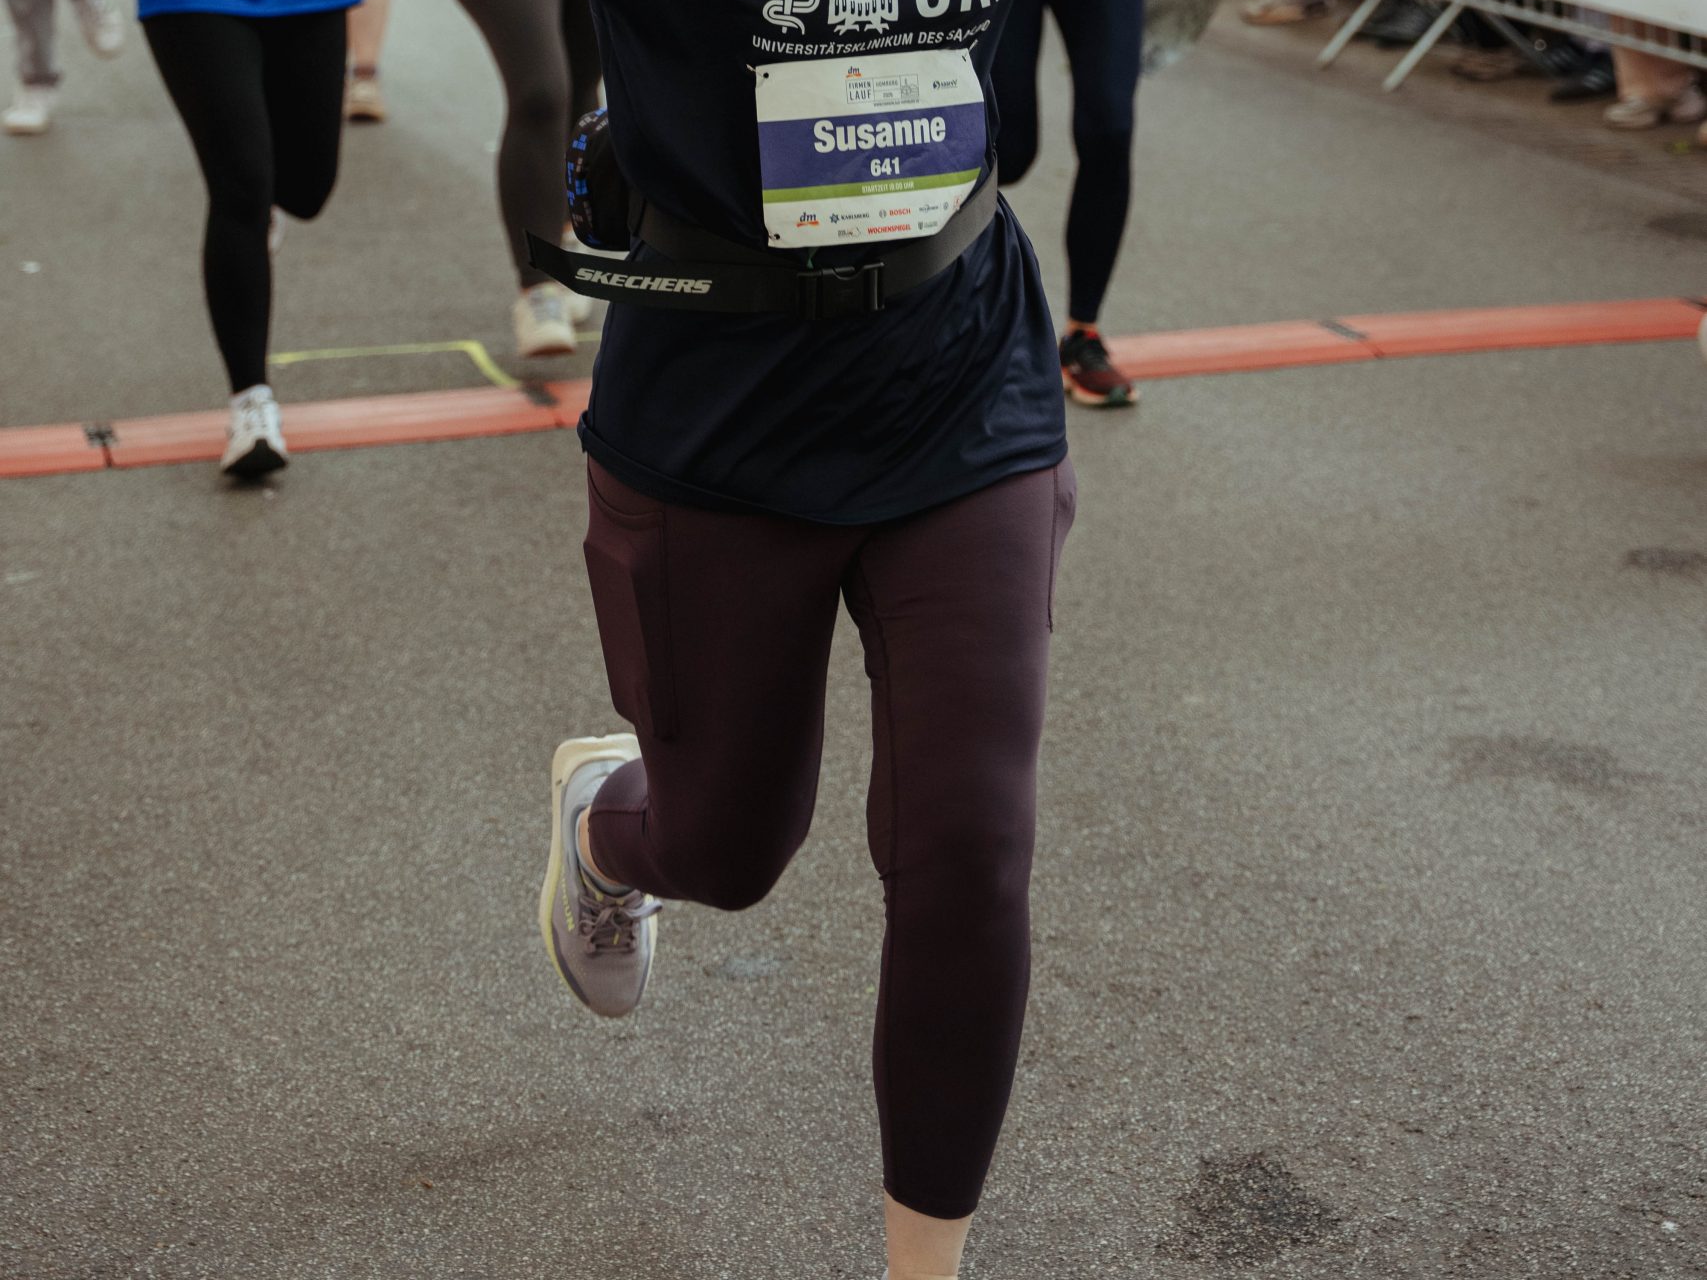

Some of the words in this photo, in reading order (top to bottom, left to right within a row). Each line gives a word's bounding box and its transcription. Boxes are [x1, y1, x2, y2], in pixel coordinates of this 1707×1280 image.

[752, 32, 914, 56] UNIVERSITÄTSKLINIKUM
[917, 32, 945, 45] DES
[848, 80, 871, 90] FIRMEN
[849, 89, 872, 101] LAUF
[813, 115, 946, 154] Susanne
[870, 156, 901, 177] 641
[799, 212, 817, 223] dm
[889, 207, 911, 217] BOSCH
[867, 223, 912, 236] WOCHENSPIEGEL
[574, 267, 713, 294] SKECHERS
